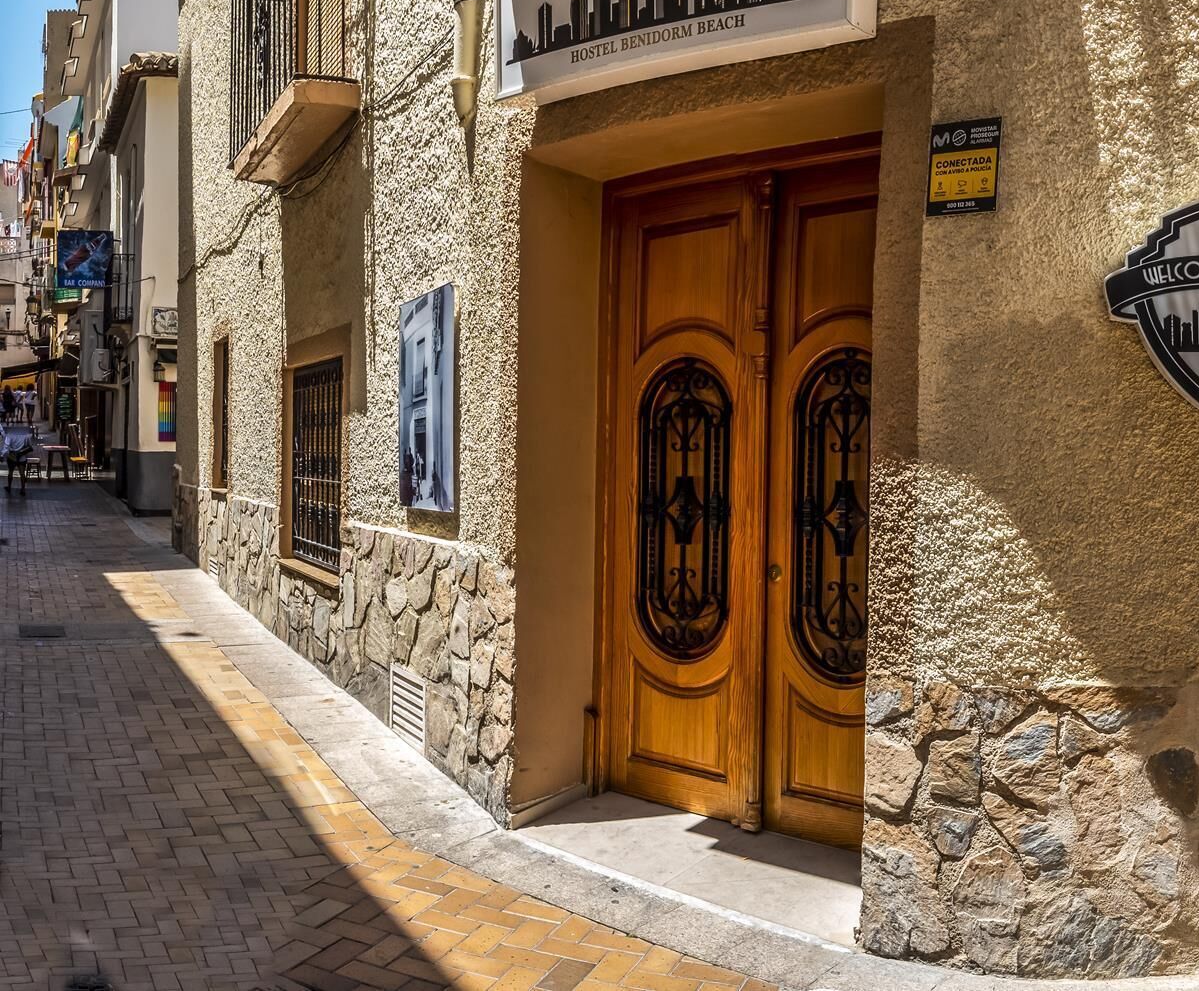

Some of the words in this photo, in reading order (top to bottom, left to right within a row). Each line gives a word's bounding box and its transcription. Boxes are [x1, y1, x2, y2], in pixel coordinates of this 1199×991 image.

[570, 41, 618, 64] HOSTEL
[620, 23, 697, 52] BENIDORM
[697, 14, 746, 35] BEACH
[970, 125, 998, 133] MOVISTAR
[970, 131, 999, 139] PROSEGUR
[935, 156, 992, 169] CONECTADA
[64, 279, 75, 287] BAR
[77, 279, 106, 288] COMPANY
